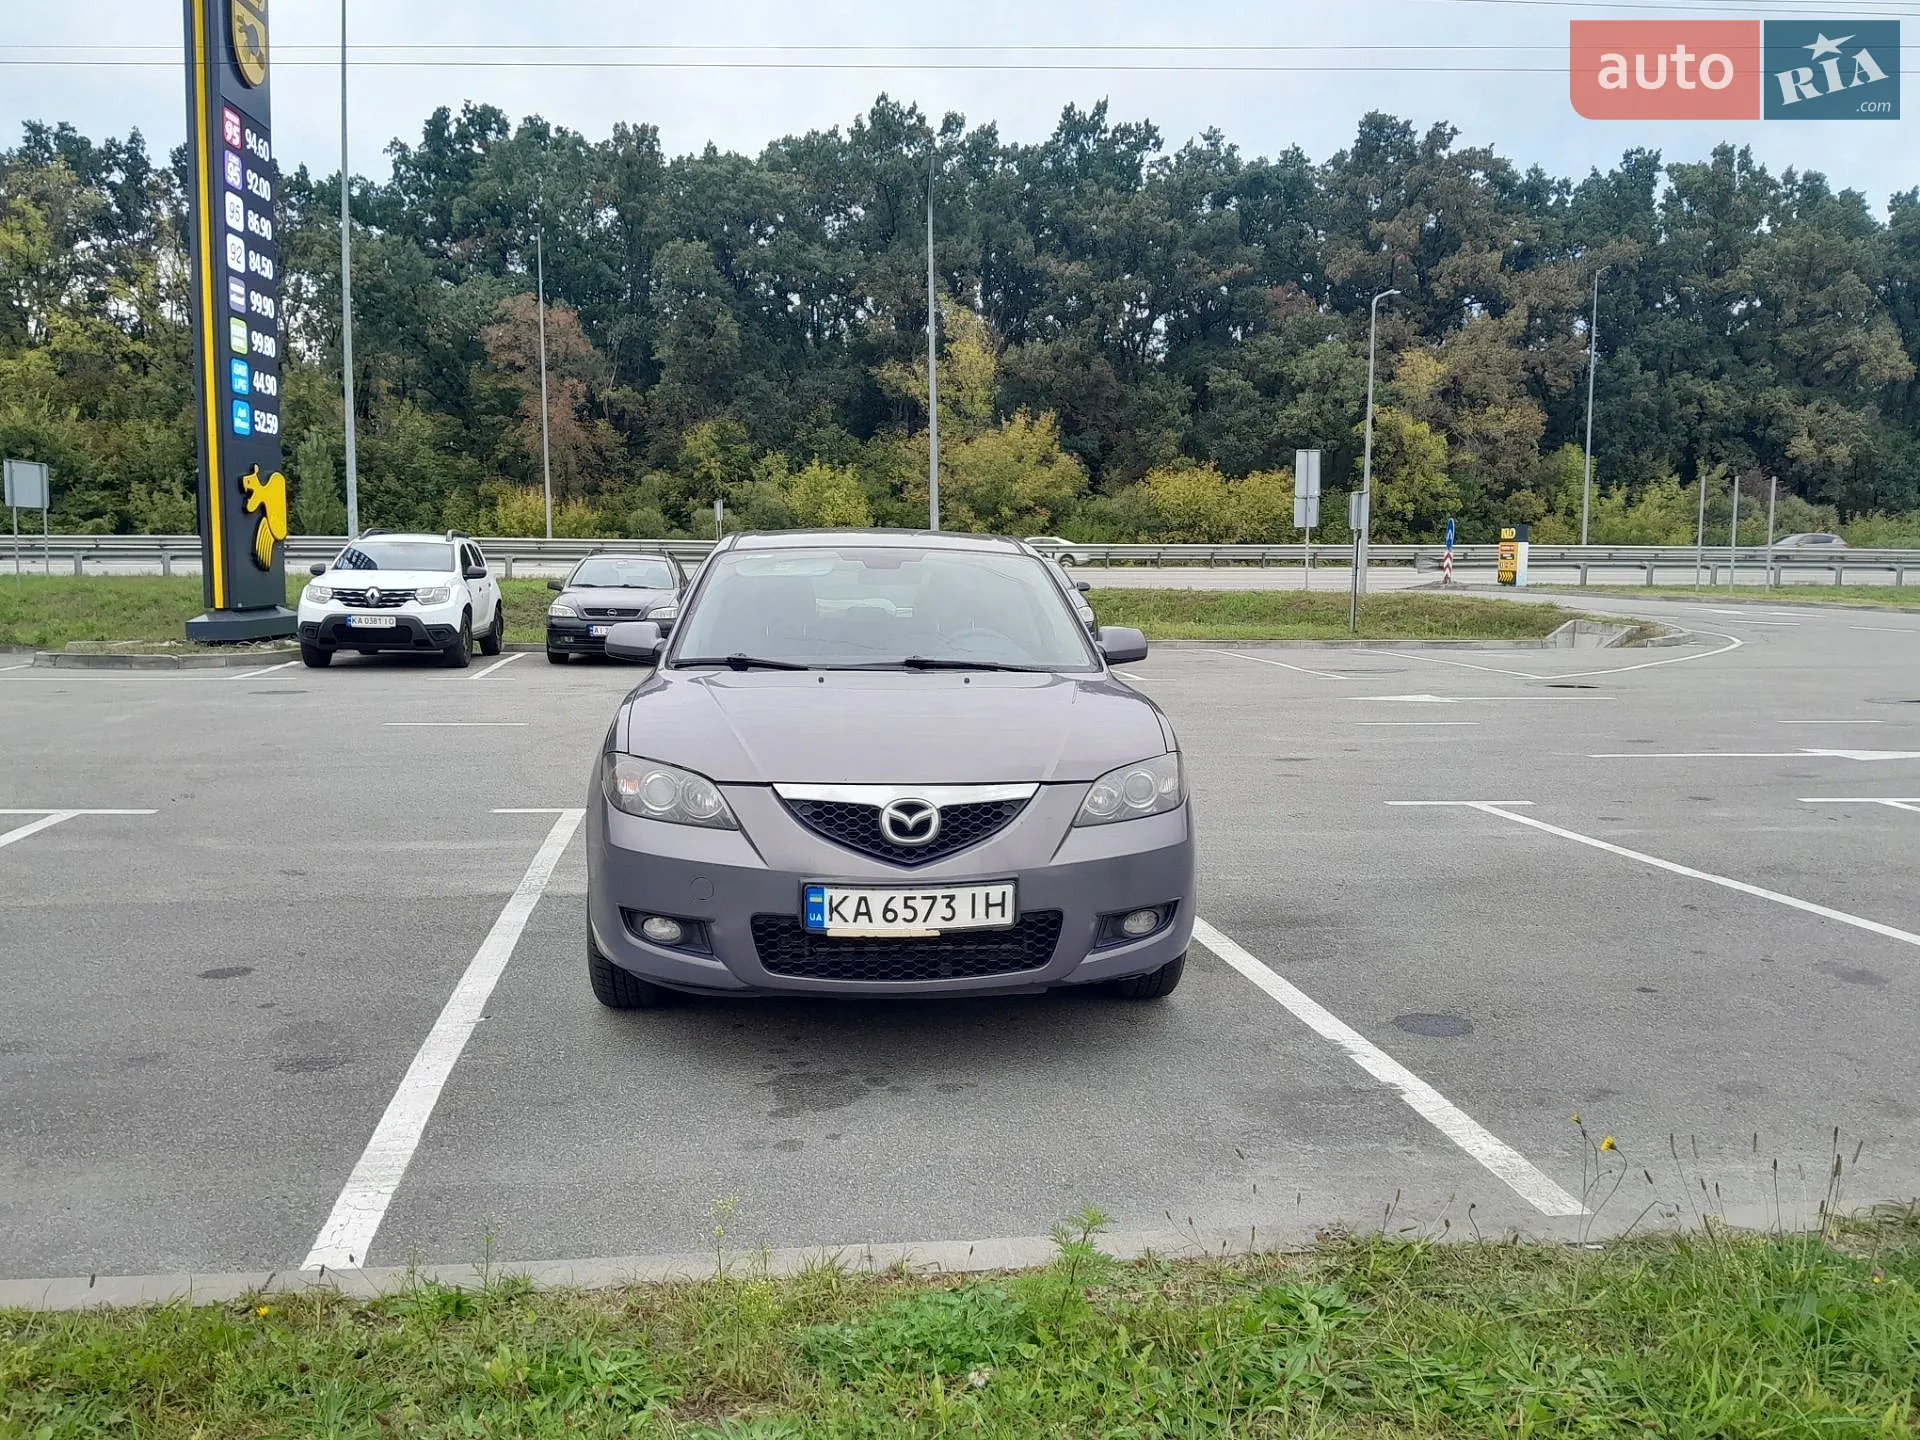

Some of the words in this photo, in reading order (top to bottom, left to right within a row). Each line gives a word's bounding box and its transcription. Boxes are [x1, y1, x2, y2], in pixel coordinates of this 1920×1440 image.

[225, 120, 240, 146] 95
[245, 128, 270, 162] 94.60
[227, 162, 241, 186] 95
[229, 202, 241, 222] 95
[247, 209, 272, 241] 86.90
[230, 243, 243, 264] 92
[248, 249, 274, 280] 84.50
[250, 290, 275, 319] 99.90
[253, 370, 277, 396] 44.90
[254, 410, 279, 435] 52.59
[809, 912, 823, 922] UA
[828, 895, 873, 923] KA
[882, 894, 956, 923] 6573
